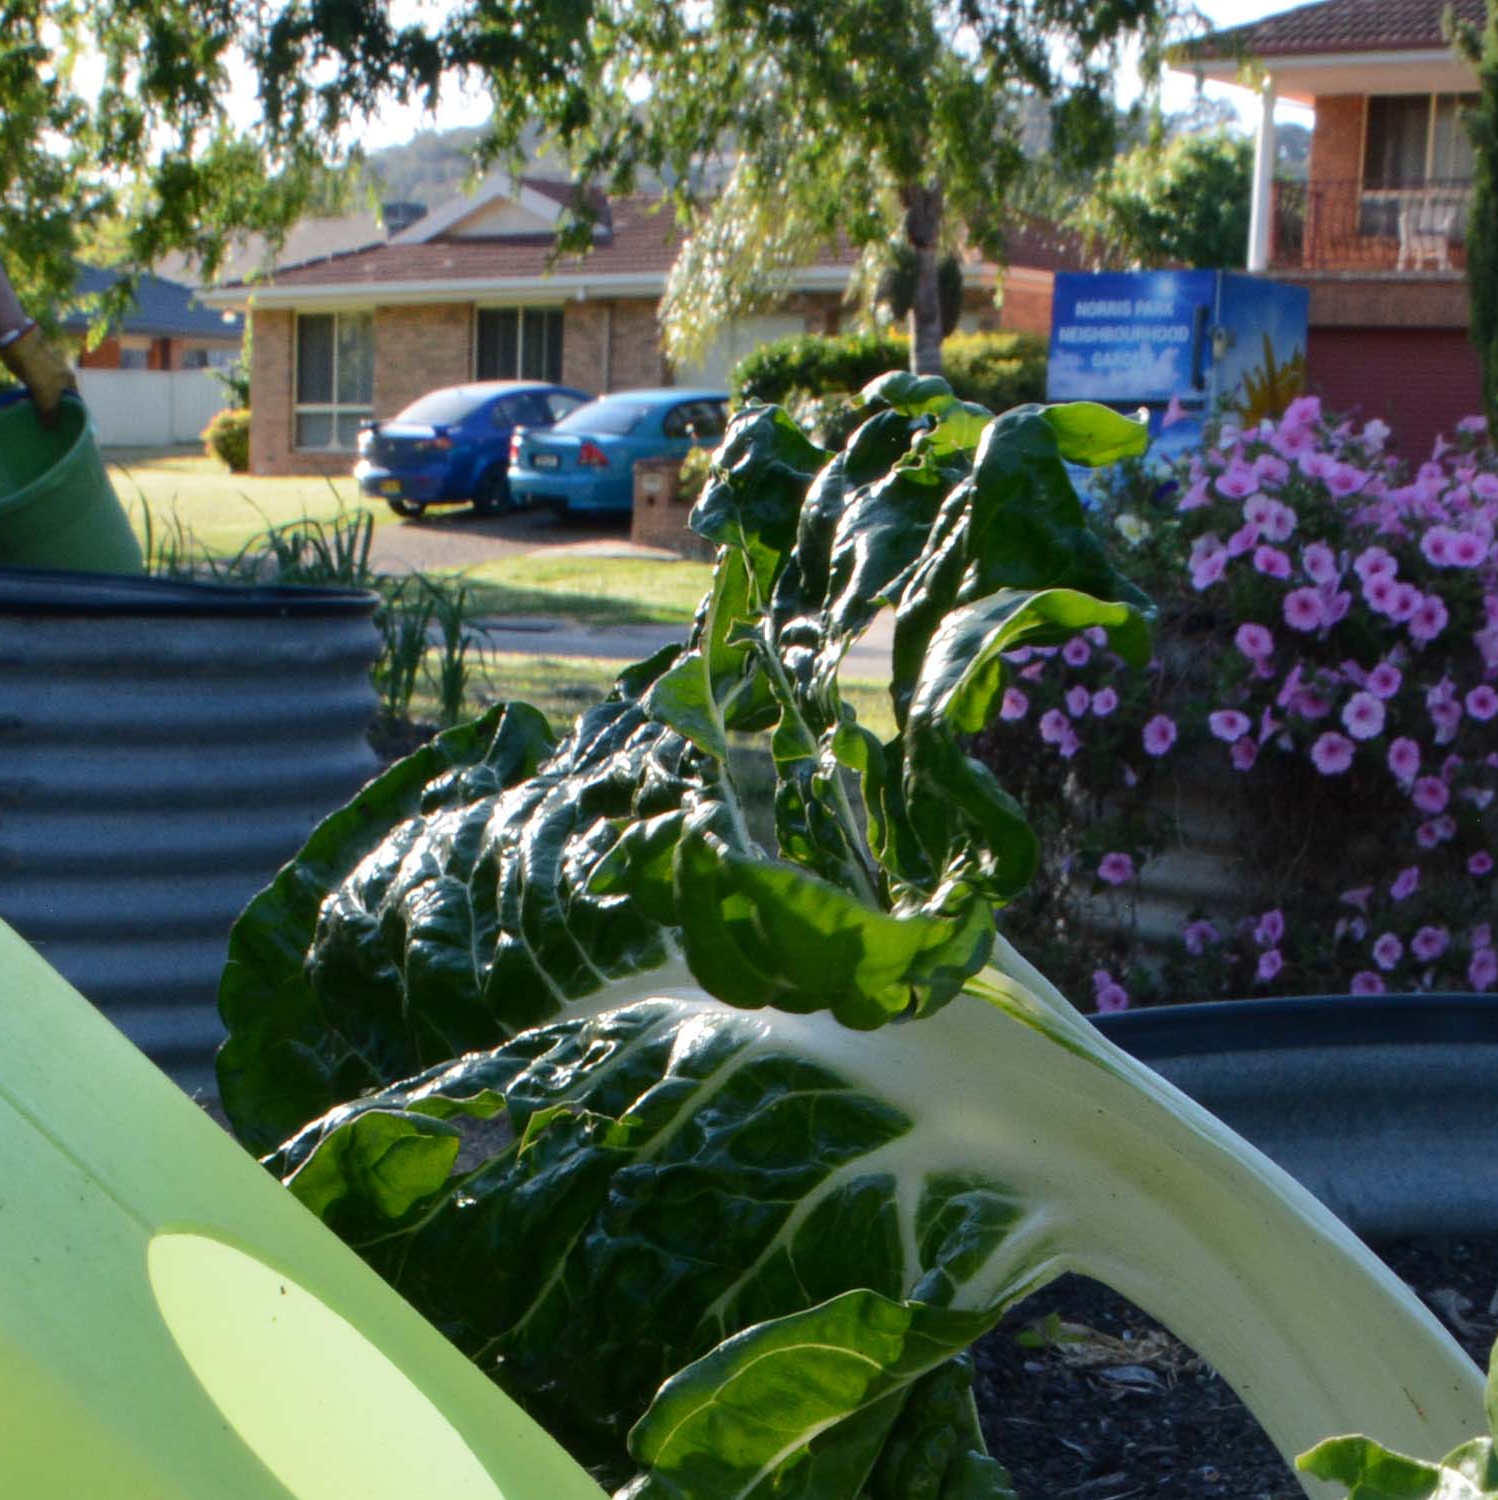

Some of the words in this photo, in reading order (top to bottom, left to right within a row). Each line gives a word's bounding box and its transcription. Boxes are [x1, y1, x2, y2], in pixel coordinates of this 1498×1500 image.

[1075, 300, 1132, 317] NORRIS
[1135, 300, 1175, 316] PARK
[1059, 325, 1190, 342] NEIGHBOURHOOD
